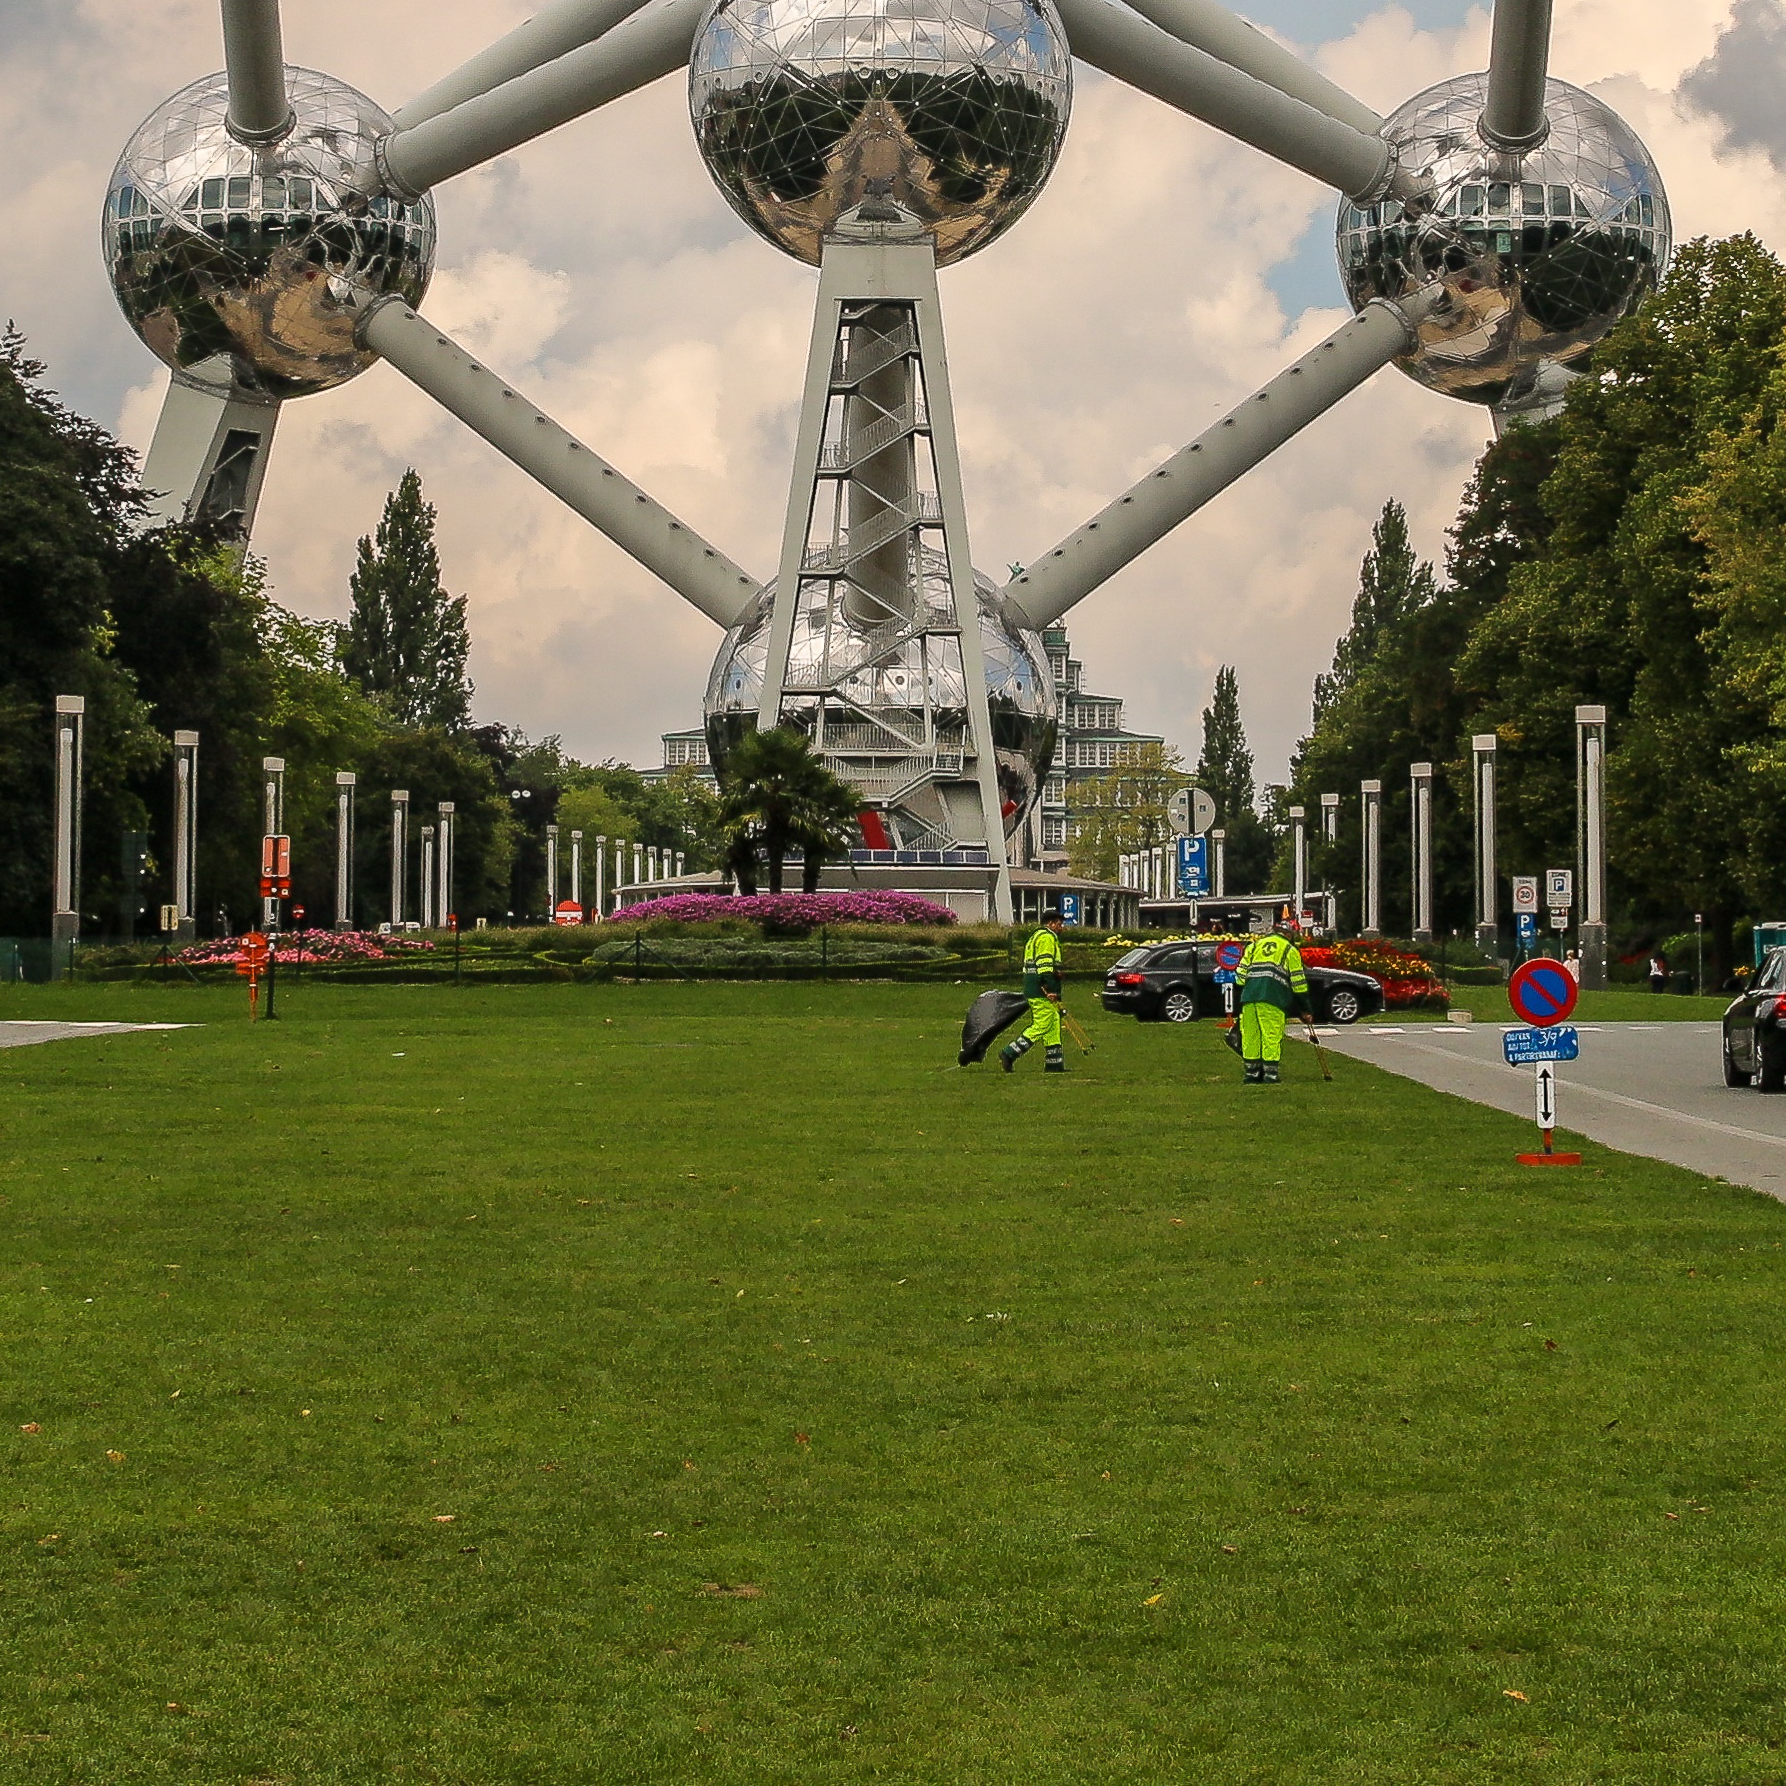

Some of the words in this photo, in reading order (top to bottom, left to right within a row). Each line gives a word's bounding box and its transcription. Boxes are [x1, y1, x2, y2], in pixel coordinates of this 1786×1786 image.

[1184, 839, 1200, 862] P
[1555, 880, 1563, 891] P
[1520, 890, 1531, 899] 30
[1064, 897, 1074, 911] P
[1520, 915, 1530, 929] P
[1538, 1030, 1558, 1047] 3/9
